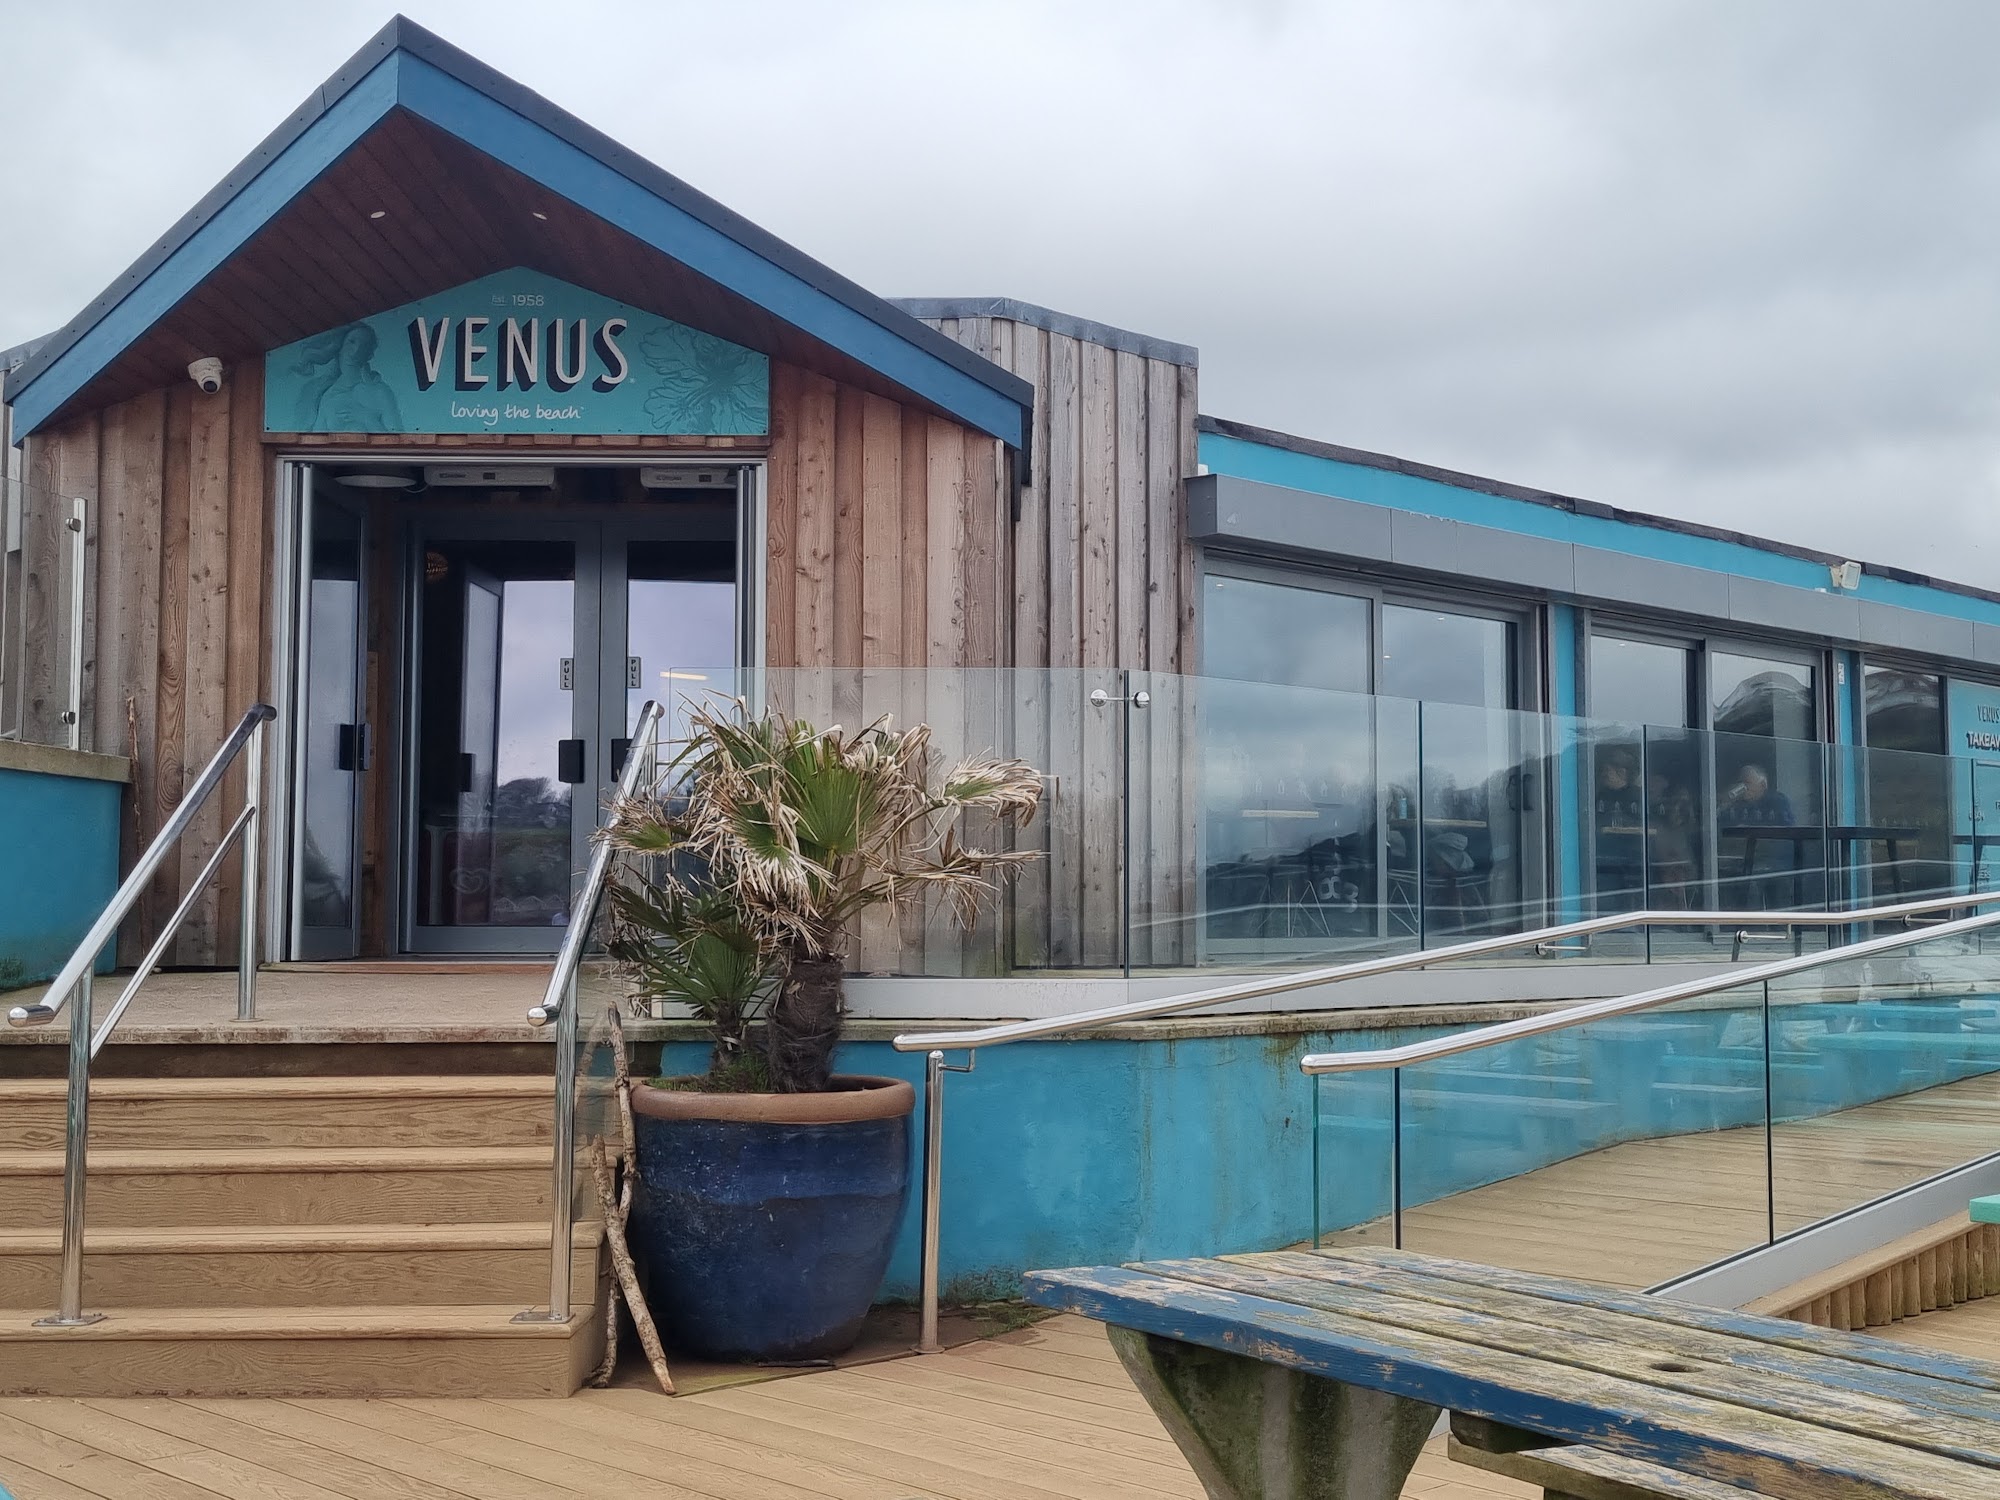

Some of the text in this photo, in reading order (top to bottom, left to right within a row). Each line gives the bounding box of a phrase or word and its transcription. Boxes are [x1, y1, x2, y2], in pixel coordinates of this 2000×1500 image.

[512, 294, 545, 307] 1958
[408, 316, 629, 393] VENUS
[451, 400, 581, 426] loving the beach
